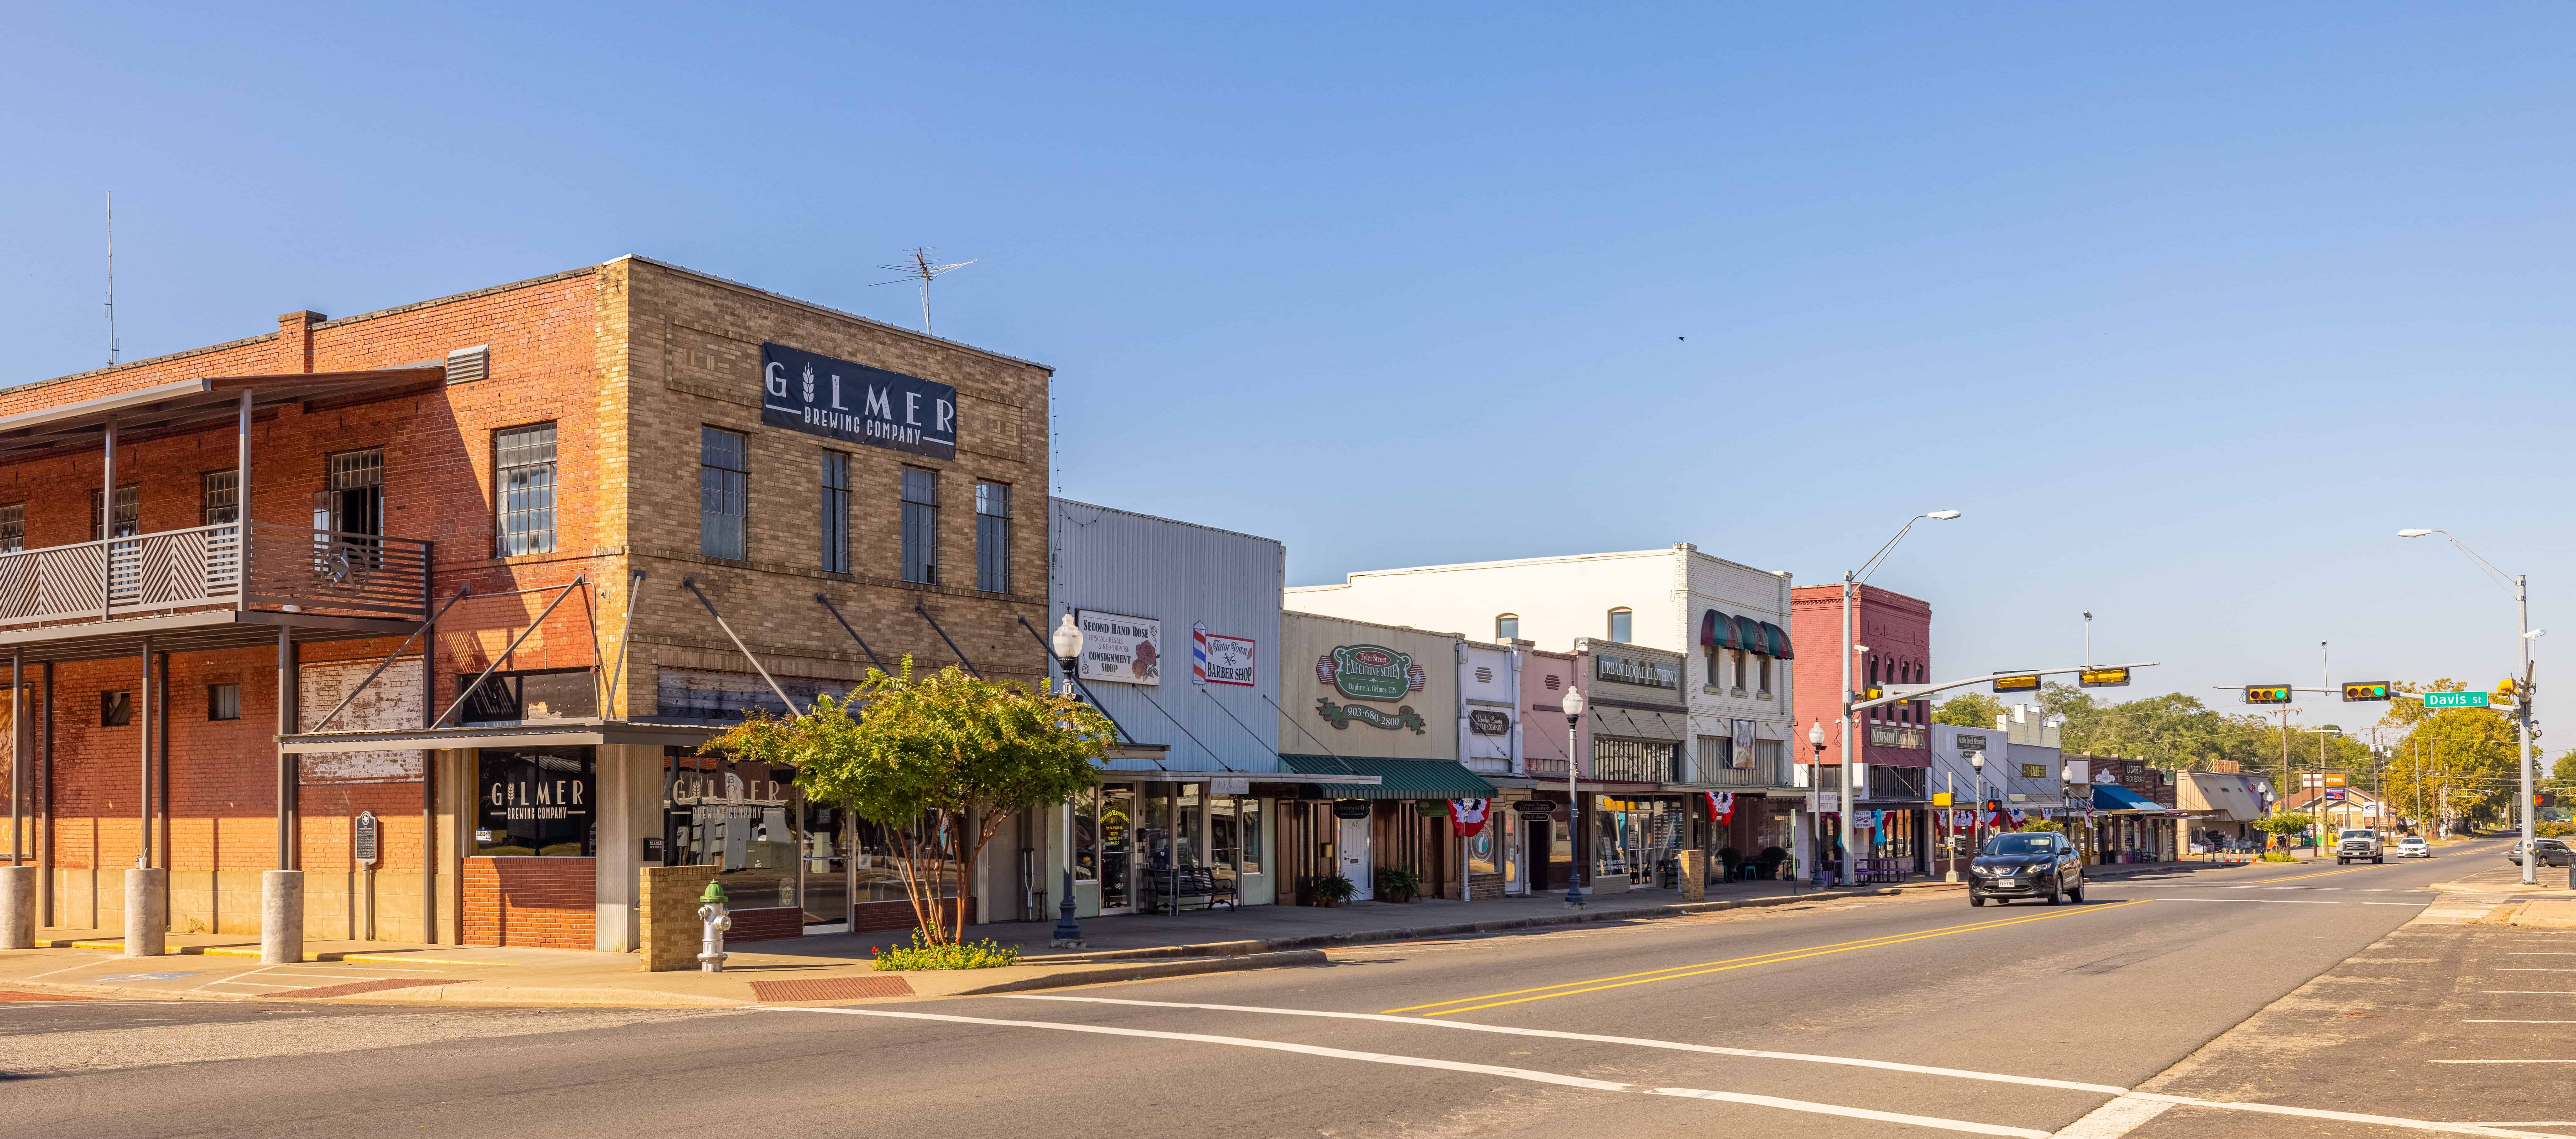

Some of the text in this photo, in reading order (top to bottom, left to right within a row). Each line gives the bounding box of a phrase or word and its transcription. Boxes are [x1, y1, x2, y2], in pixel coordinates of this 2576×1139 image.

[805, 406, 921, 445] BREWING COMPANY
[1084, 619, 1148, 638] SECOND HAND ROSE
[1088, 634, 1108, 643] UPSCALE
[1103, 644, 1130, 652] RE-PURPOSE
[1213, 639, 1247, 656] Tator Town
[1088, 651, 1131, 664] CONSIGNMENT
[1360, 652, 1387, 663] Tyler Street
[1101, 663, 1118, 673] SHOP
[1207, 662, 1252, 681] BARBER SHOP
[1346, 654, 1399, 679] EXECUTIVE SUITES
[1601, 661, 1676, 683] URBAN LOCAL CLOTHING
[1348, 683, 1365, 692] Daphne
[1371, 685, 1388, 693] Grimes,
[2430, 694, 2466, 705] Davis
[1872, 729, 1895, 744] NEWSOM
[1896, 731, 1907, 745] LAW
[2030, 766, 2040, 777] CAFE
[508, 807, 566, 819] BREWING COMPANY
[693, 807, 762, 819] BREWING COMPANY
